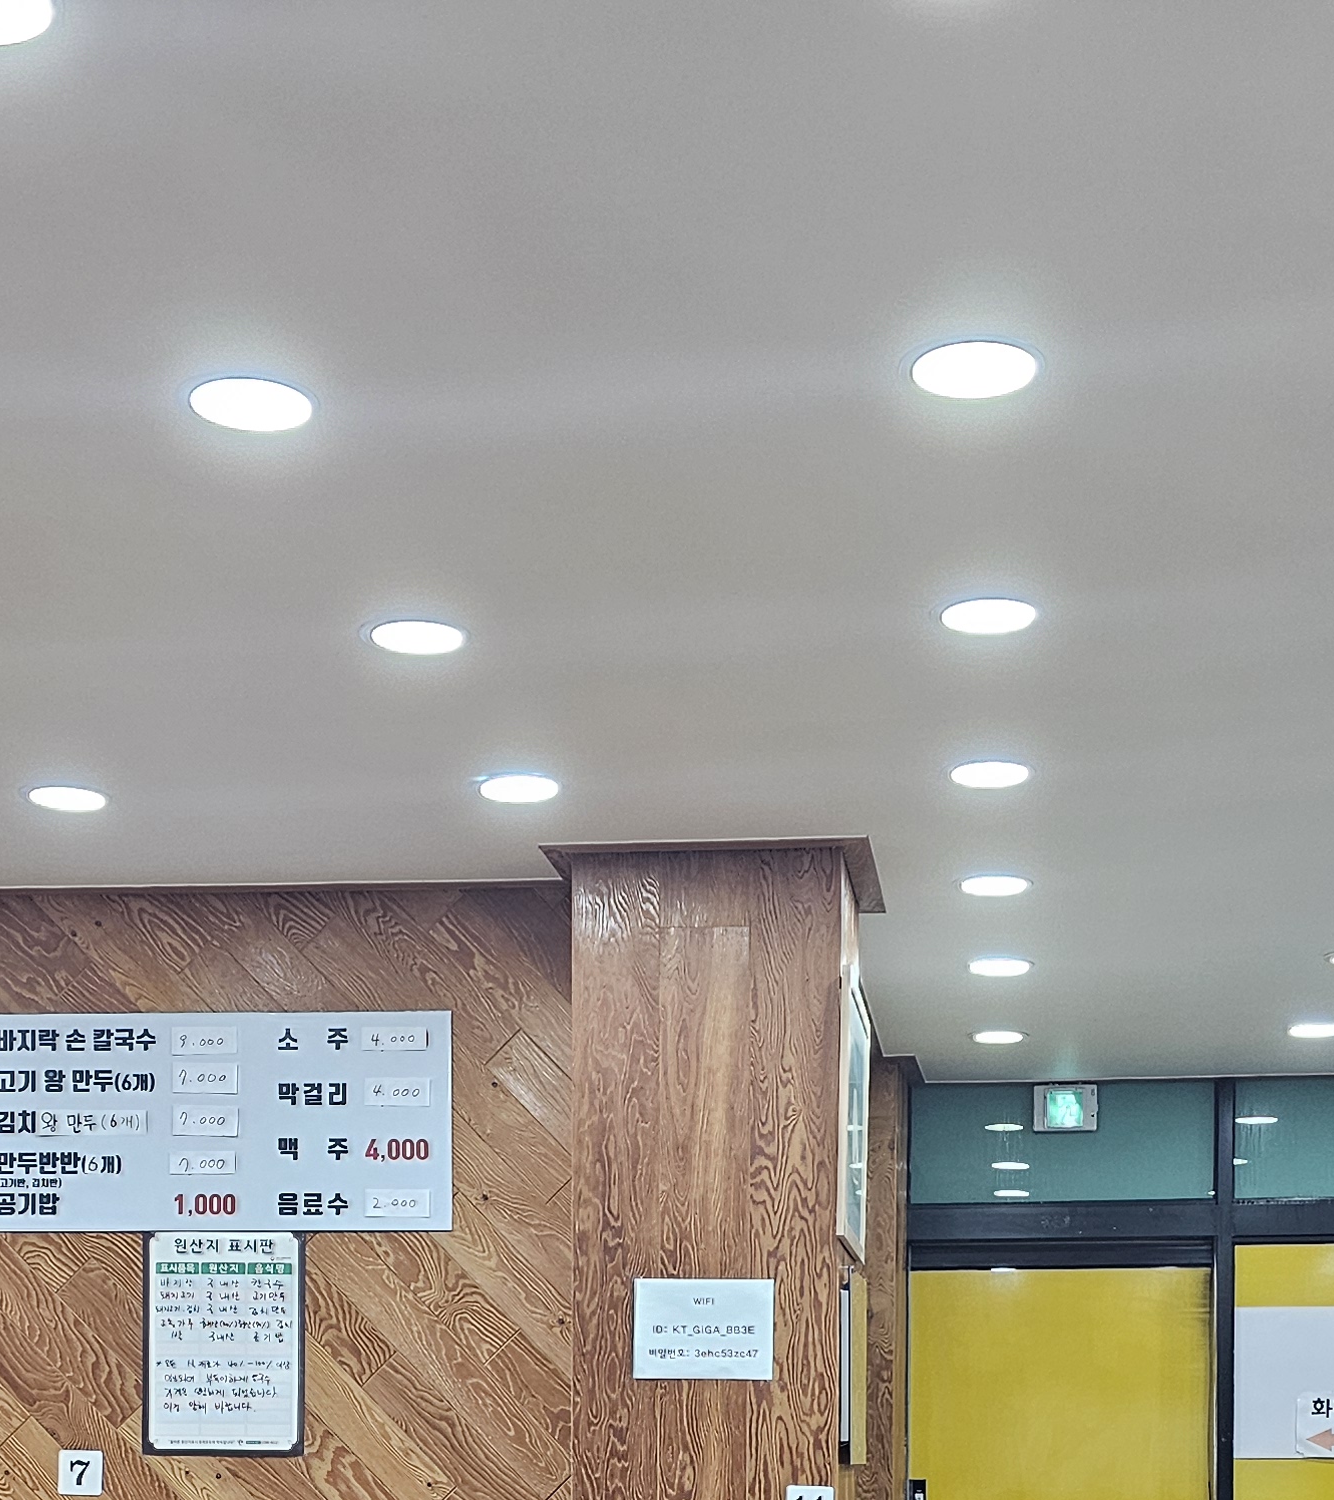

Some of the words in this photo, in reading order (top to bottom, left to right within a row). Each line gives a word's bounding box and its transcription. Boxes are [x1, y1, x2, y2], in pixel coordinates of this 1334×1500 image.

[65, 1028, 87, 1052] 손
[92, 1028, 157, 1052] 칼국수
[277, 1027, 299, 1051] 소
[326, 1027, 349, 1051] 주
[370, 1033, 416, 1047] 4.000
[43, 1069, 66, 1093] 왕
[71, 1069, 156, 1093] 만두(6개)
[178, 1068, 227, 1086] 7.000
[277, 1082, 348, 1106] 막걸리
[372, 1084, 421, 1098] 4.000
[40, 1111, 58, 1132] 왕
[179, 1111, 226, 1126] 7.000
[277, 1137, 299, 1161] 맥
[327, 1137, 349, 1161] 주
[364, 1138, 430, 1163] 4,000
[178, 1157, 226, 1173] 7.000
[174, 1193, 237, 1217] 1,000
[277, 1192, 349, 1216] 음료수
[371, 1197, 417, 1209] 2.000
[173, 1238, 220, 1254] 원산지
[227, 1238, 275, 1254] 표시판
[208, 1263, 239, 1274] 원산지
[254, 1263, 285, 1274] 음식명
[693, 1297, 715, 1306] WIFI
[652, 1325, 668, 1335] ID:
[70, 1459, 91, 1486] 7
